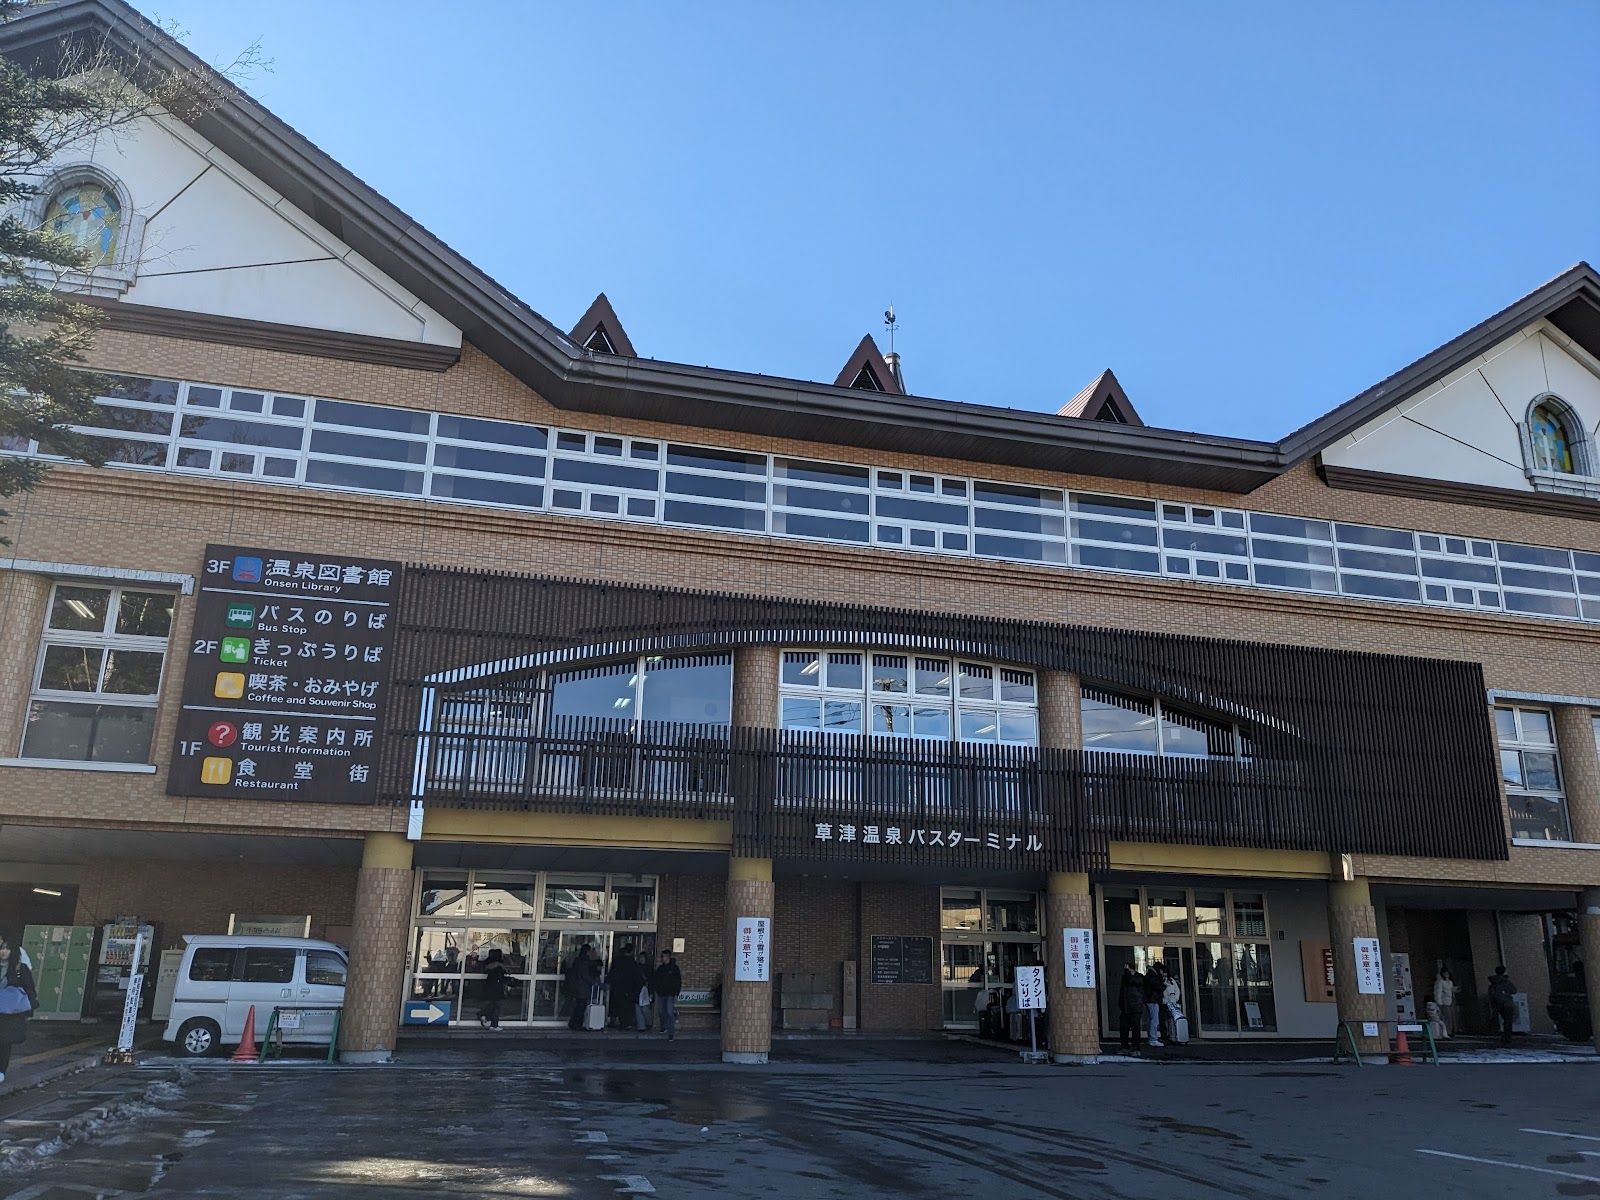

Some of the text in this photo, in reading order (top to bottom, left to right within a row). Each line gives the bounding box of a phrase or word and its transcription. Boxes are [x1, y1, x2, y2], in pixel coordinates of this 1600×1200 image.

[206, 559, 231, 575] 3F
[265, 558, 393, 587] 温泉図書館
[264, 577, 342, 594] Onsen Library
[259, 604, 388, 630] バスのりば
[257, 622, 307, 636] Bus Stop
[193, 639, 219, 654] 2F
[252, 637, 384, 664] きっぷうりば
[252, 656, 289, 668] Ticket
[247, 673, 380, 698] 喫茶・おみやげ
[247, 693, 377, 711] Coffee and Souvenir Shop
[241, 721, 374, 748] 観光案内所
[179, 740, 203, 756] 1F
[240, 742, 352, 757] Tourist Information
[234, 777, 299, 790] Restaurant
[815, 822, 1043, 852] 草津温泉バスターミナル
[1032, 967, 1042, 1007] タクシー
